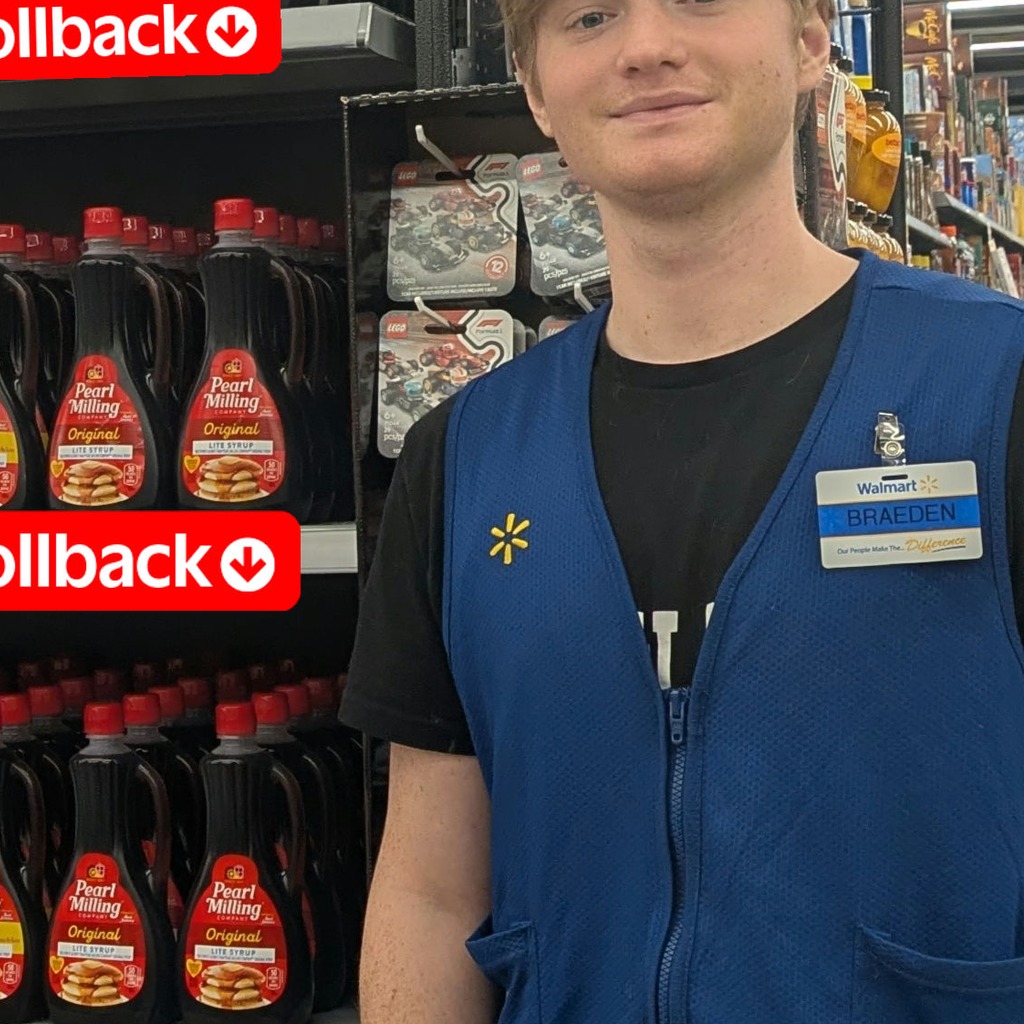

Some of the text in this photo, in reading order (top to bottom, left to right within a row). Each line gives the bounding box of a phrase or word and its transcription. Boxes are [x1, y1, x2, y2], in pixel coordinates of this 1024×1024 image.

[523, 164, 541, 177] LEGO
[387, 323, 406, 332] LEGO
[76, 383, 114, 398] Pearl
[211, 377, 253, 393] Pearl
[69, 399, 120, 418] Milling
[204, 393, 260, 412] Milling
[68, 428, 120, 444] Original
[204, 423, 260, 439] Original
[857, 480, 918, 495] Walmart
[847, 502, 956, 527] BRAEDEN
[76, 880, 115, 898] Pearl
[213, 882, 255, 899] Pearl
[69, 896, 121, 918] Milling
[206, 898, 262, 920] Milling
[68, 926, 121, 942] Original
[206, 928, 262, 944] Original
